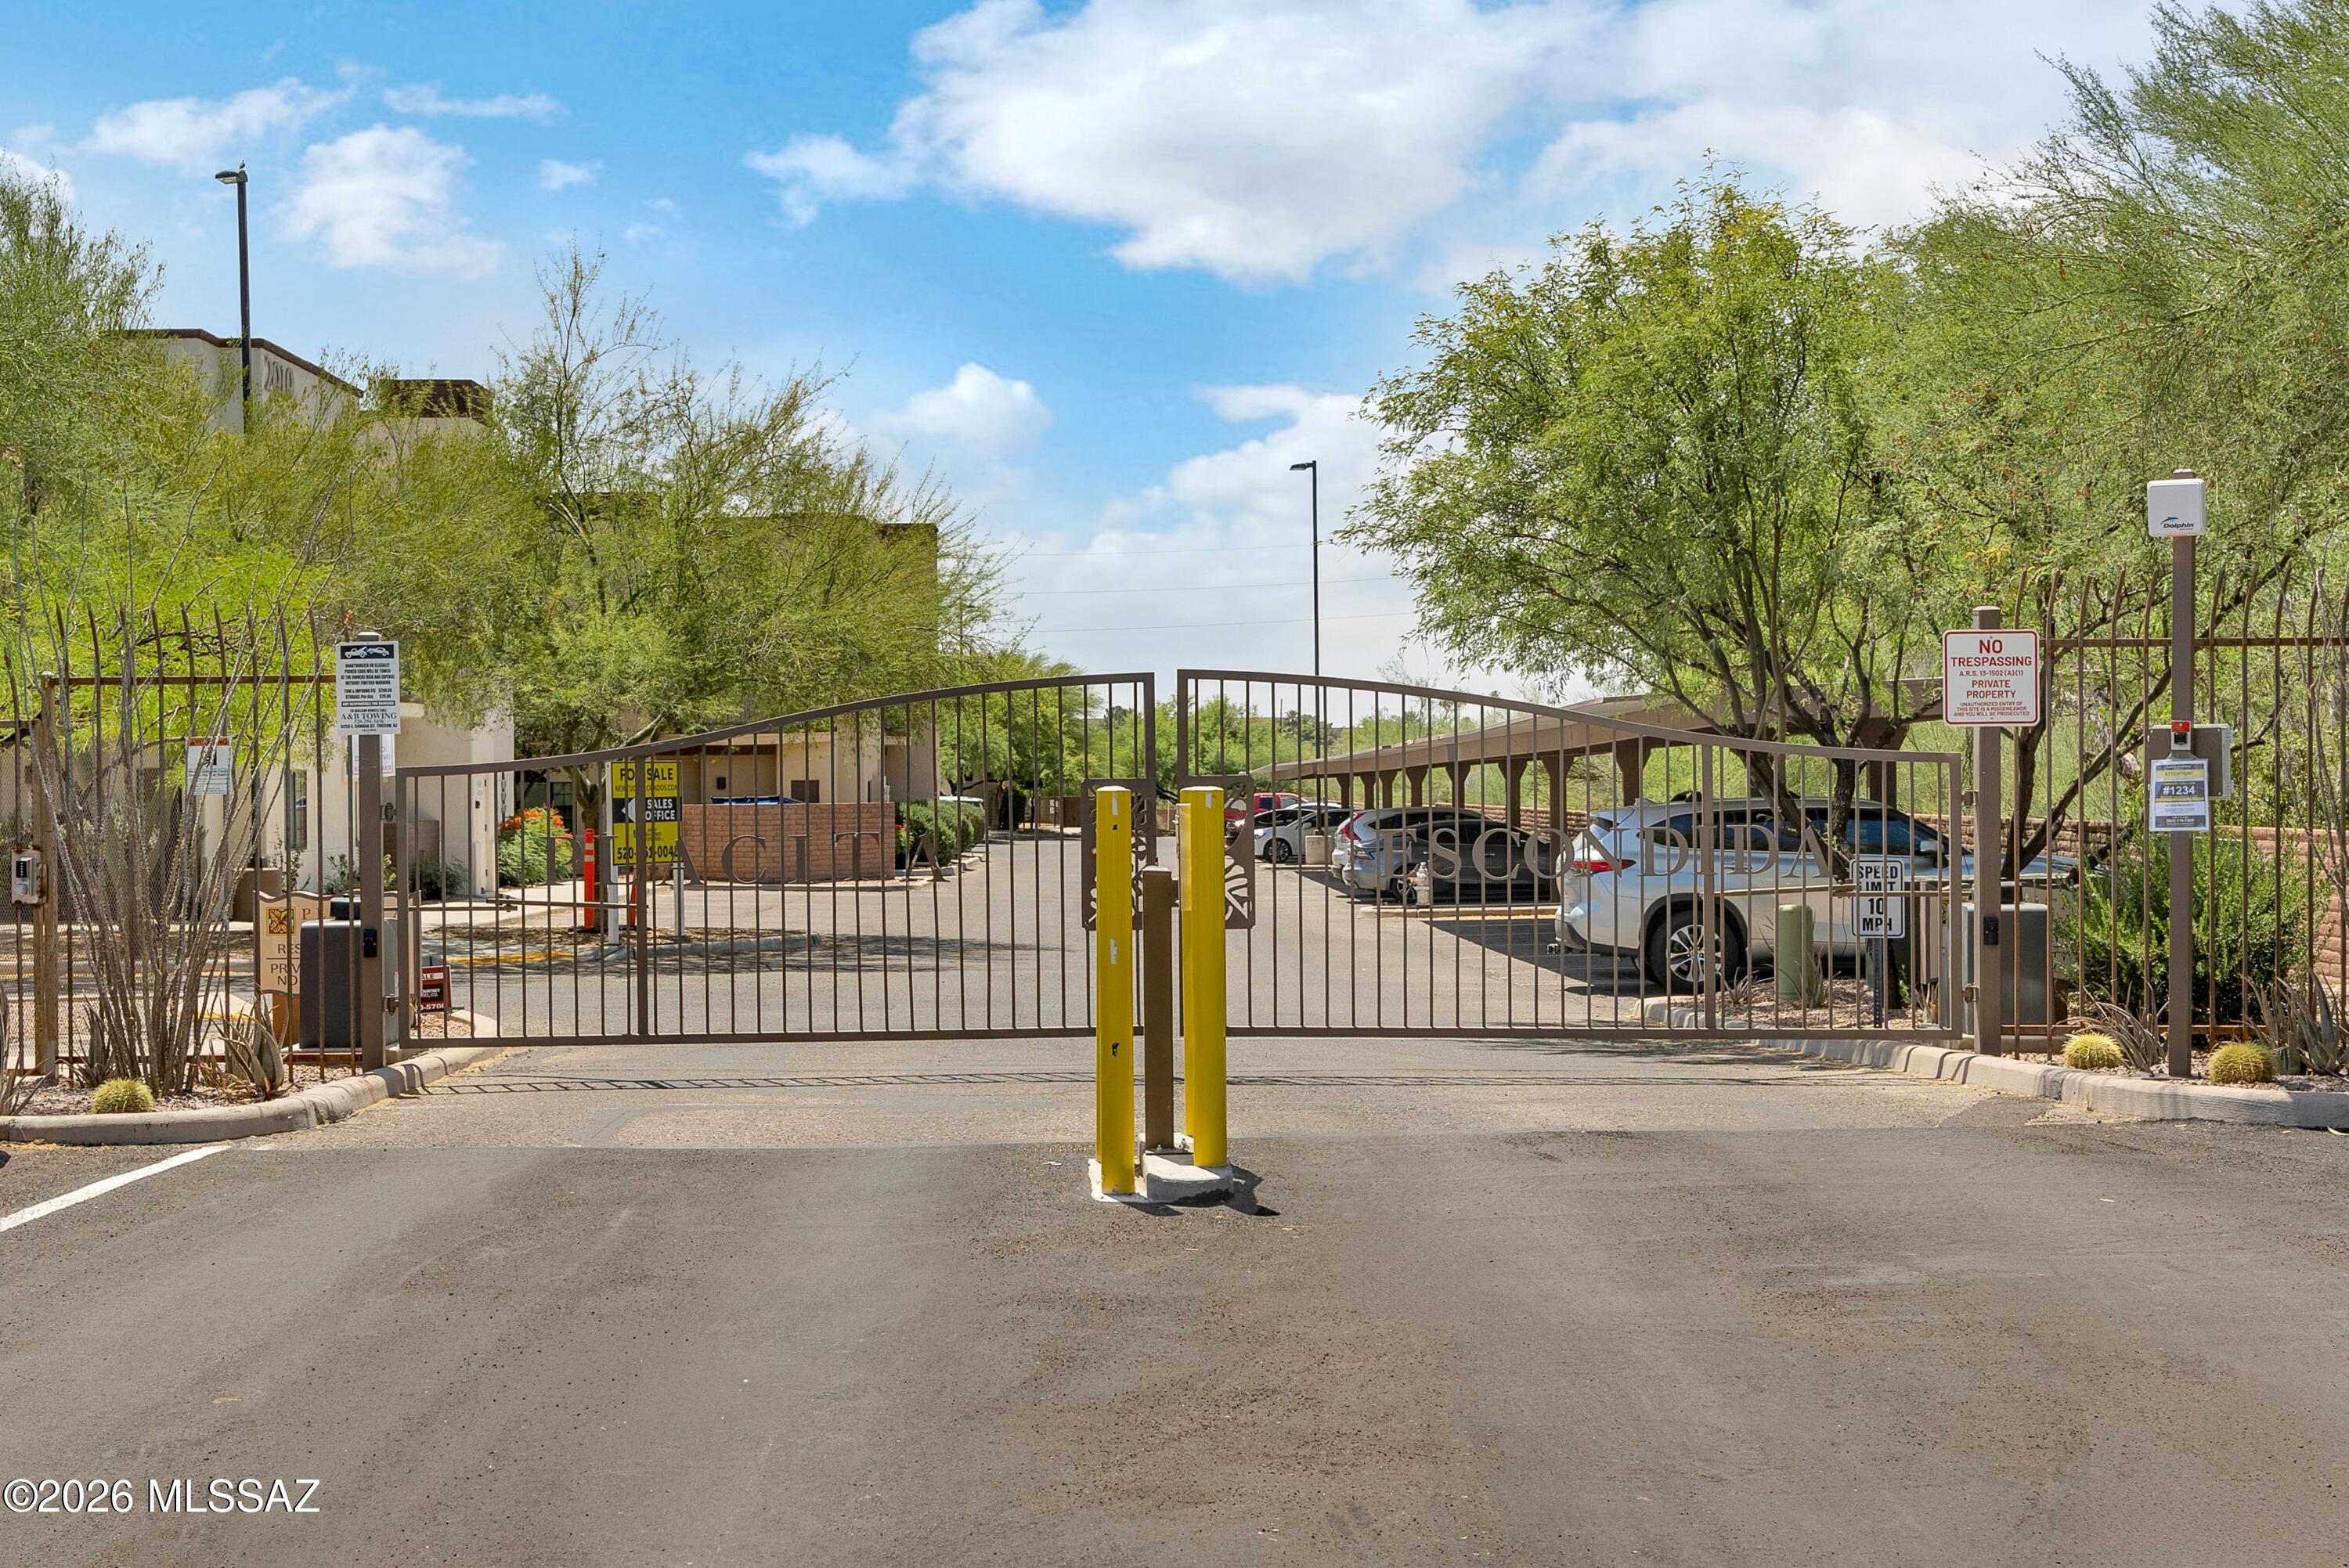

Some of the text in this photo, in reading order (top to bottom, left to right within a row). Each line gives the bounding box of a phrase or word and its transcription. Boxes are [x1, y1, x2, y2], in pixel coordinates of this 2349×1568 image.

[1979, 639, 2003, 654] NO
[1950, 656, 2032, 667] TRESPASSING
[1966, 690, 2016, 699] PROPERTY
[646, 768, 673, 781] SALE
[2163, 785, 2196, 795] #1234
[646, 798, 673, 809] SALES
[644, 810, 675, 820] OFICE
[1379, 824, 1838, 880] ESCONDIDA
[546, 831, 950, 886] PLACITA
[1862, 917, 1893, 932] MPH
